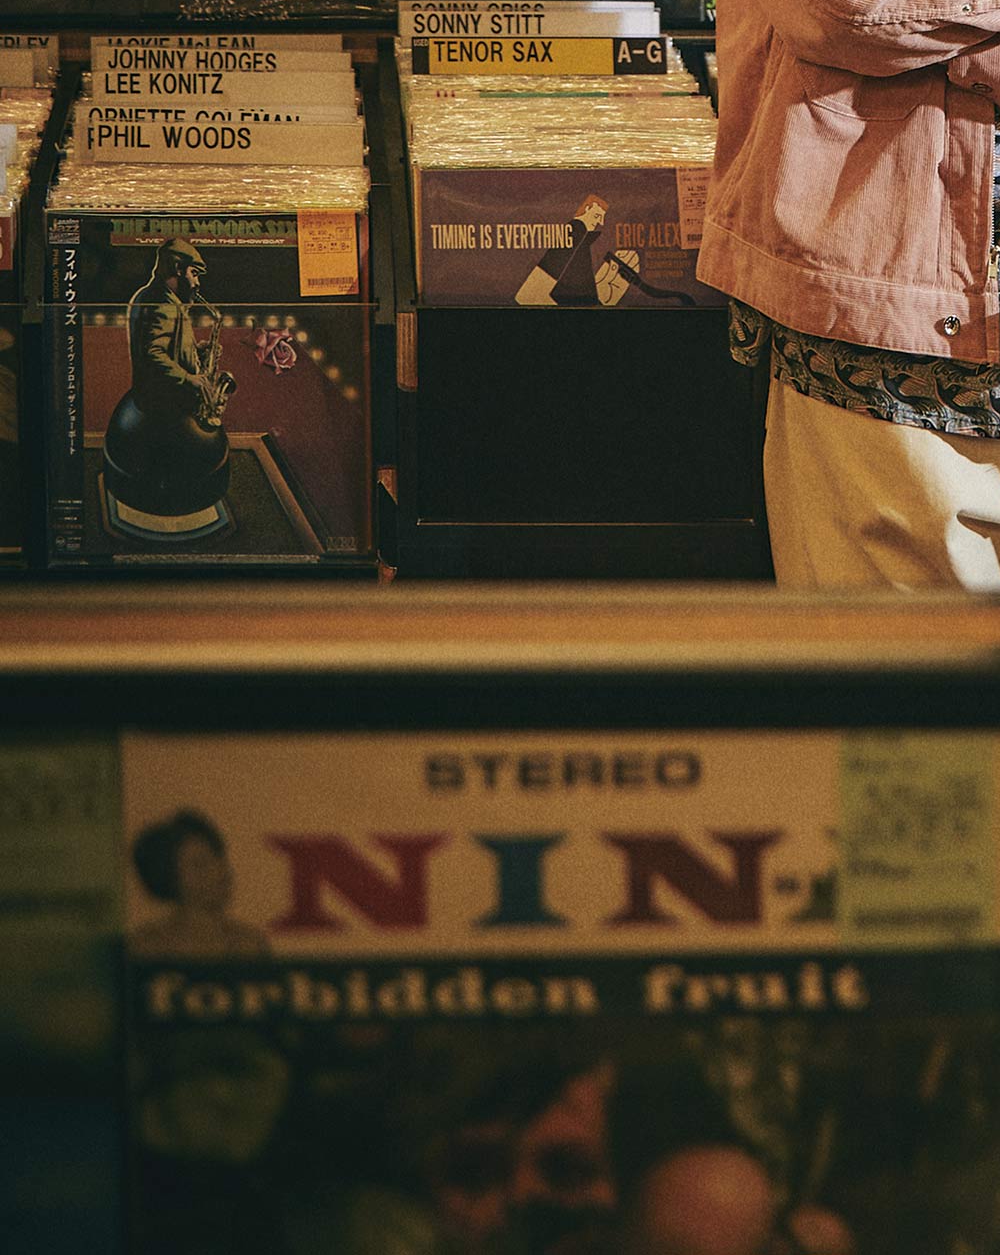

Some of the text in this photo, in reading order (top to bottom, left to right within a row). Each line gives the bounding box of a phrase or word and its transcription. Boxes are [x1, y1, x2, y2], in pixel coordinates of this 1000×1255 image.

[413, 13, 545, 34] SONNY STITT
[107, 48, 278, 73] JOHNNY HODGES
[434, 41, 554, 62] TENOR SAX
[617, 40, 663, 64] A-G
[104, 73, 224, 95] LEE KONITZ
[98, 125, 252, 150] PHIL WOODS
[190, 219, 264, 237] WOODS
[430, 224, 476, 249] TIMING
[480, 224, 492, 249] IS
[496, 224, 574, 249] EVERYTHING
[614, 223, 646, 246] ERIC
[423, 750, 704, 792] STEREO
[262, 828, 838, 932] NIN
[144, 961, 869, 1022] forbidden fruit
